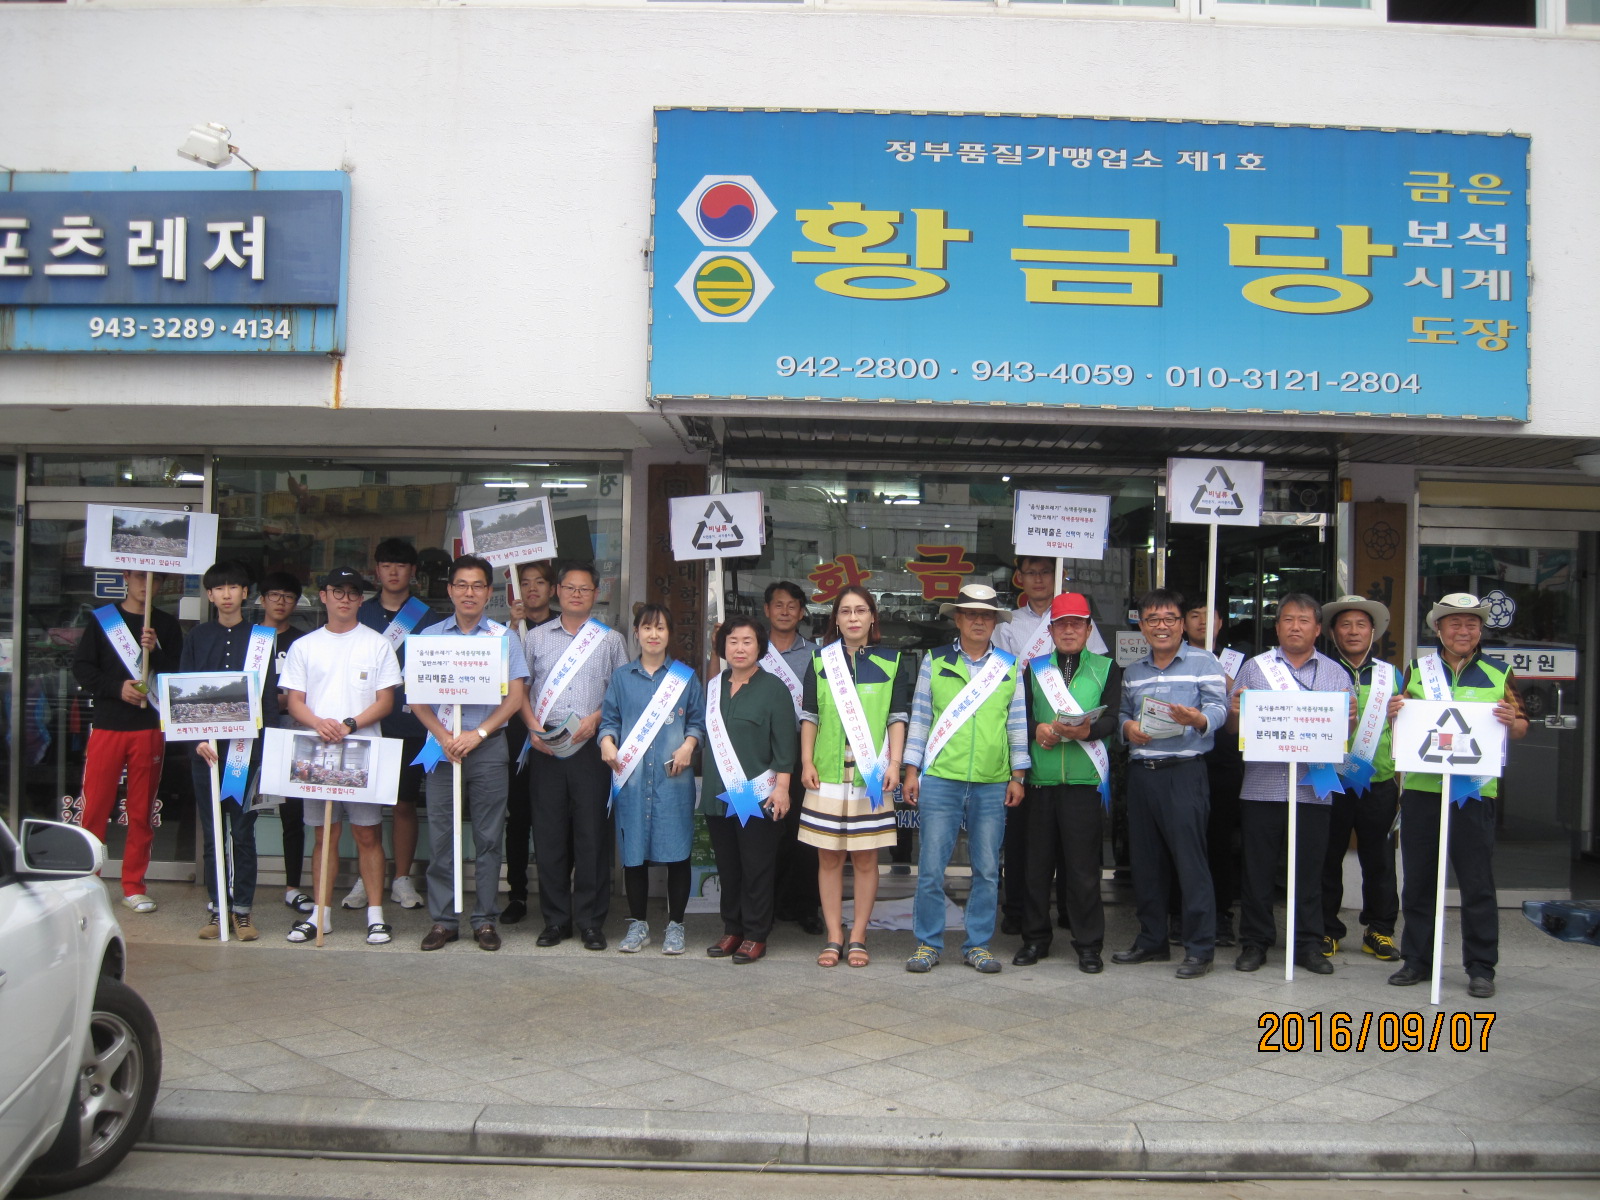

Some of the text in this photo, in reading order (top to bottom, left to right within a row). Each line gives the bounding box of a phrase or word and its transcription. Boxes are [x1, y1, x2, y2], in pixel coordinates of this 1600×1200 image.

[885, 140, 1266, 171] 정부품질가맹업소 제1호
[1403, 171, 1512, 206] 금은
[1403, 221, 1509, 255] 보석
[791, 201, 1397, 314] 황금당
[1403, 267, 1512, 301] 시계
[1407, 316, 1518, 352] 도장
[776, 355, 1421, 394] 942-2800 943-4059 010-3121-2804
[708, 525, 727, 533] 비닐류
[1027, 527, 1095, 539] 분리배출은 선택이 아닌
[1046, 541, 1075, 549] 의무입니다.
[115, 556, 137, 565] 쓰레기가
[482, 554, 501, 562] 레기가
[576, 627, 600, 654] 과자봉지
[251, 637, 267, 671] 과자봉지
[417, 674, 454, 684] 분리배출은
[982, 661, 1004, 688] 과자봉지
[660, 677, 680, 708] 과자봉지
[1053, 691, 1072, 713] 분리배
[202, 726, 219, 734] 넘치고
[851, 725, 865, 741] 아닌
[1256, 730, 1295, 740] 분리배출은
[1299, 732, 1318, 740] 선택이
[300, 785, 323, 793] 사람들이
